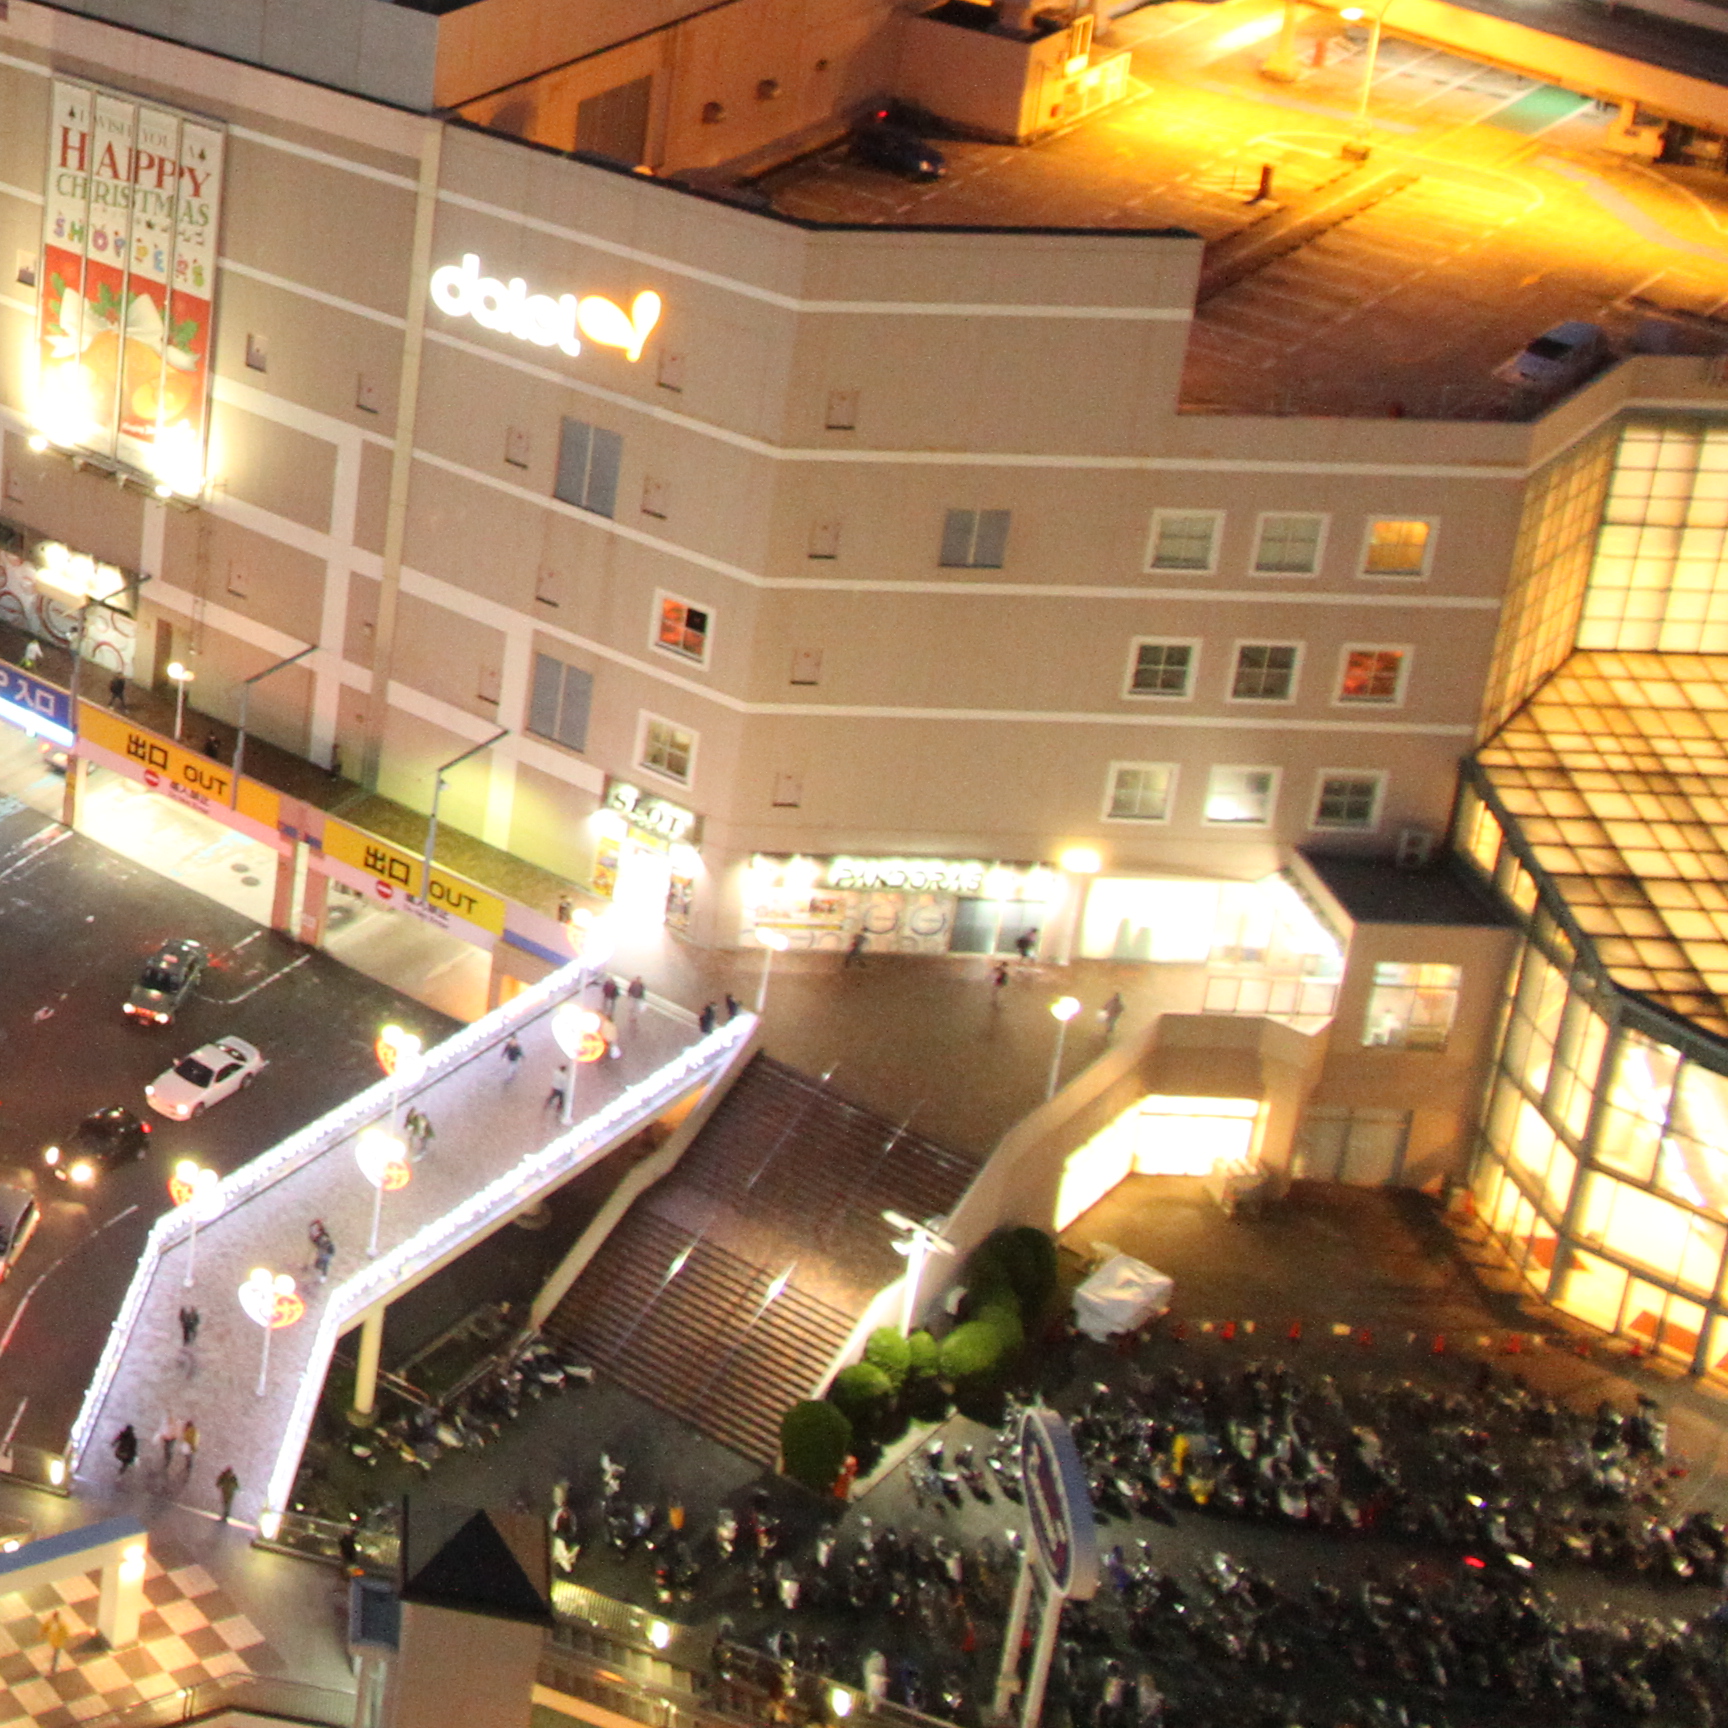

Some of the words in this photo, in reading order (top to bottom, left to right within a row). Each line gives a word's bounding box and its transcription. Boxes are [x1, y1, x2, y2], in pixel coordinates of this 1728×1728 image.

[59, 125, 211, 198] HAPPY
[56, 173, 210, 227] CHRISTMAS
[15, 679, 55, 717] 入口
[127, 733, 169, 771] 出口
[184, 764, 228, 796] OUT
[364, 844, 410, 886] 出口
[429, 879, 479, 915] OUT
